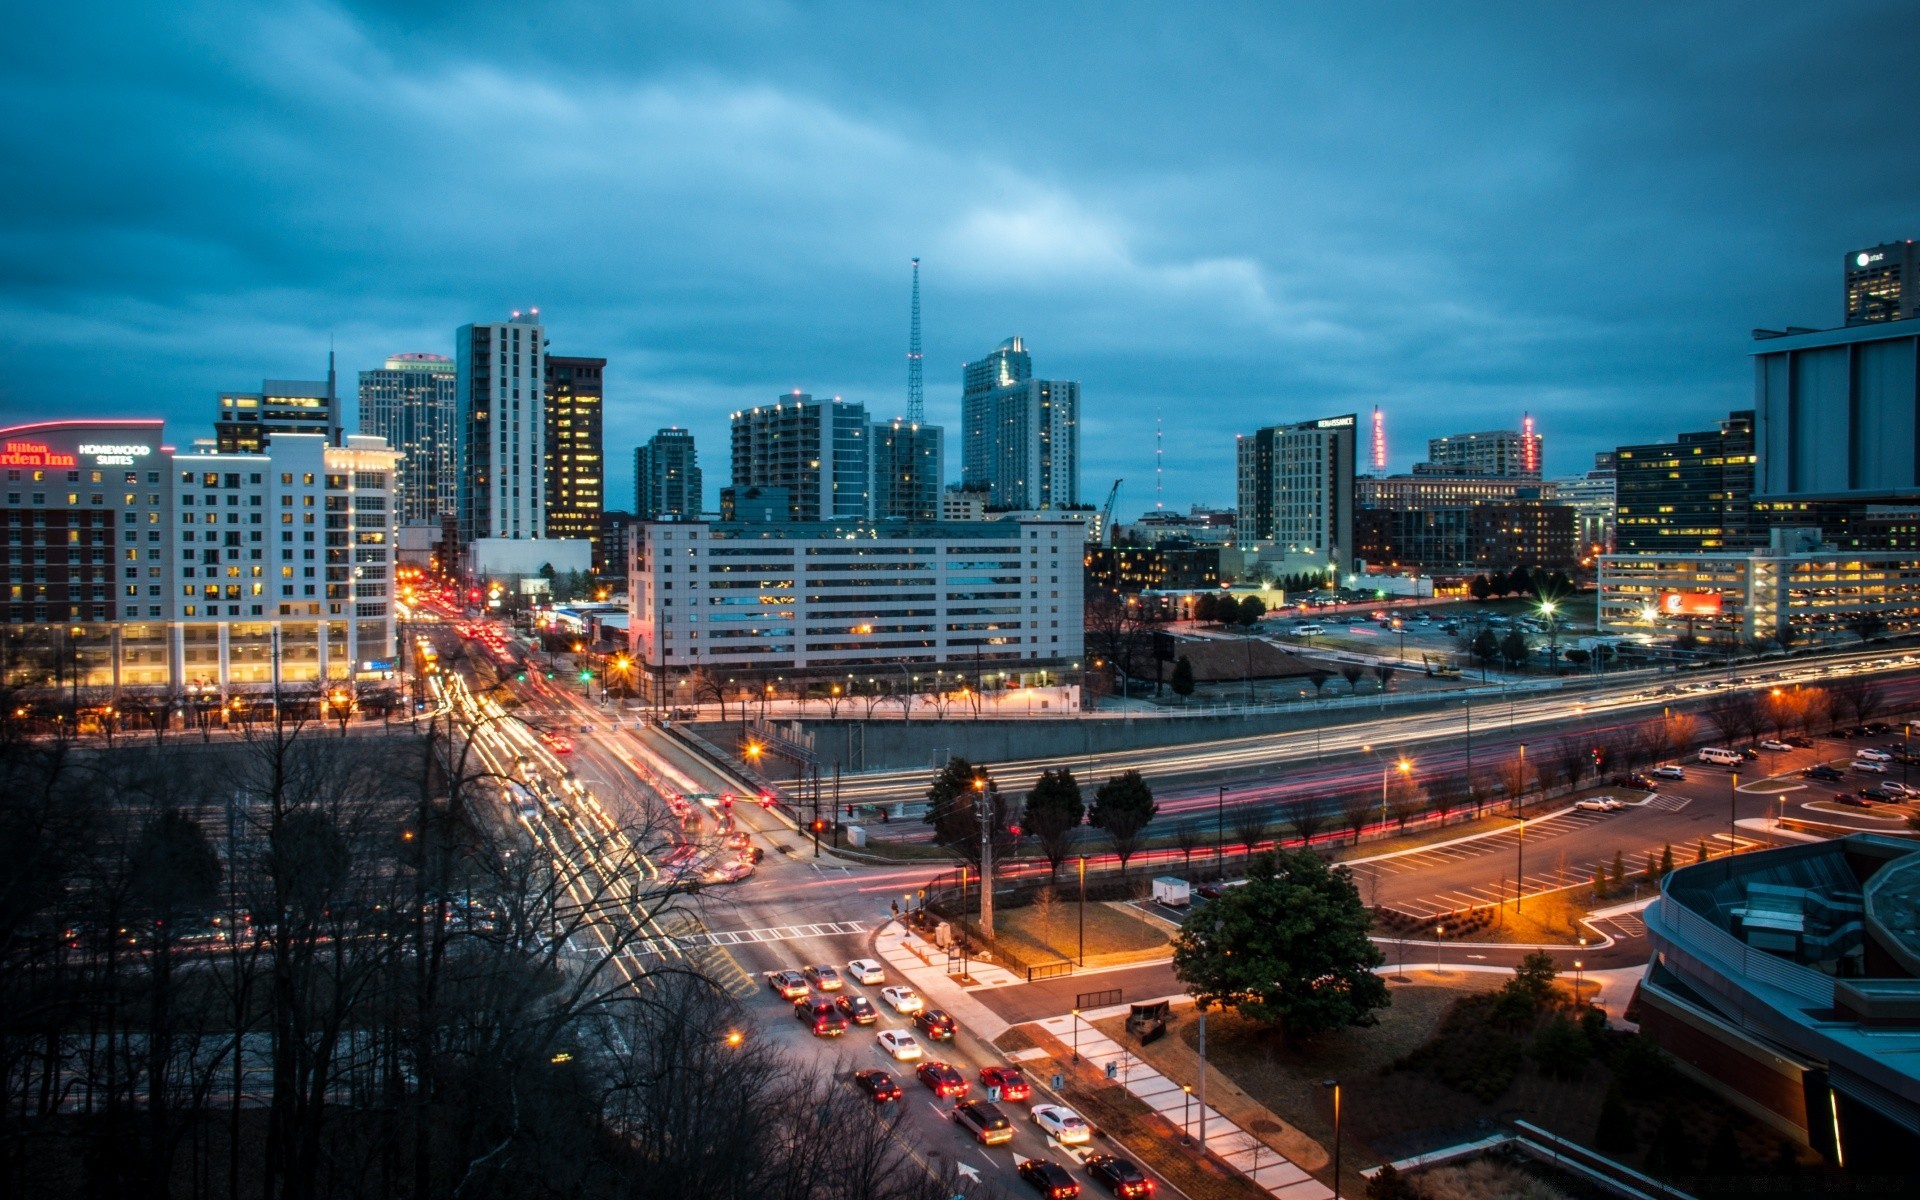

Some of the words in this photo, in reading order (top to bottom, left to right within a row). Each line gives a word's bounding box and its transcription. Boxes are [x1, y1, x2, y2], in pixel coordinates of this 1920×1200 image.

[7, 443, 47, 453] Hilton
[79, 445, 150, 455] HOMEWOOD
[0, 453, 41, 465] rden
[45, 453, 74, 465] Inn
[97, 455, 134, 465] SUITES
